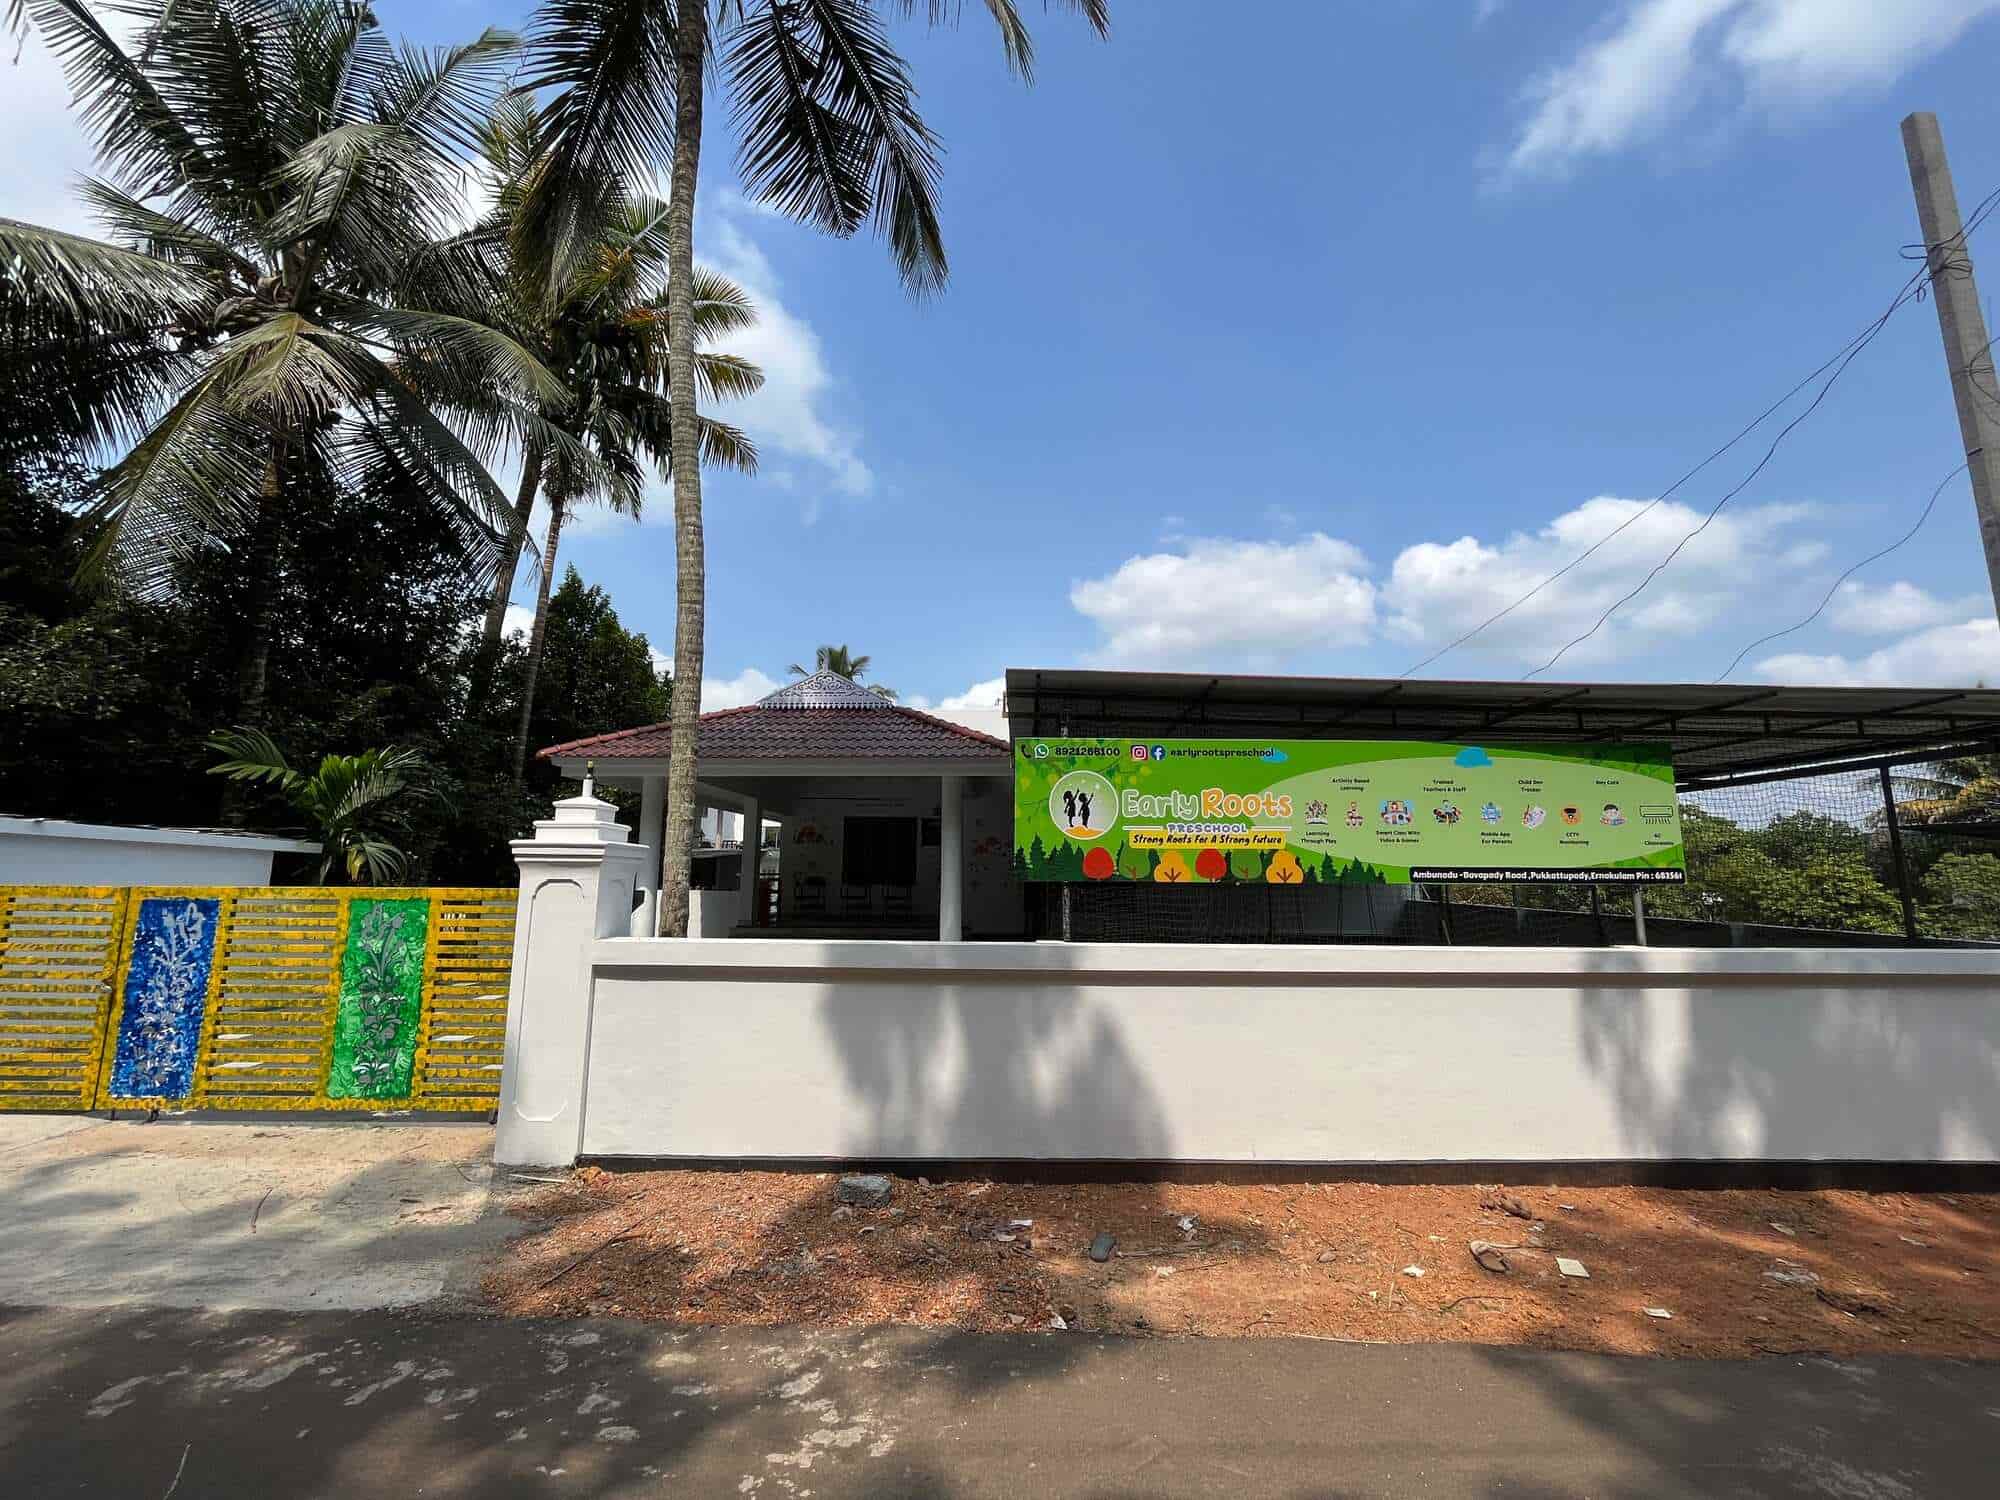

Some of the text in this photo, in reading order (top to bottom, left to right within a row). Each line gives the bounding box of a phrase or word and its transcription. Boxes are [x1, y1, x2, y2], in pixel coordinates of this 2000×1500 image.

[1170, 748, 1274, 759] earlyrootspreschool
[1121, 787, 1292, 820] Early Roots
[1167, 822, 1248, 834] PRESCHOOL
[1133, 834, 1282, 845] Strong Roots For A Strong Future
[1505, 871, 1527, 879] Road
[1636, 871, 1649, 879] Pin
